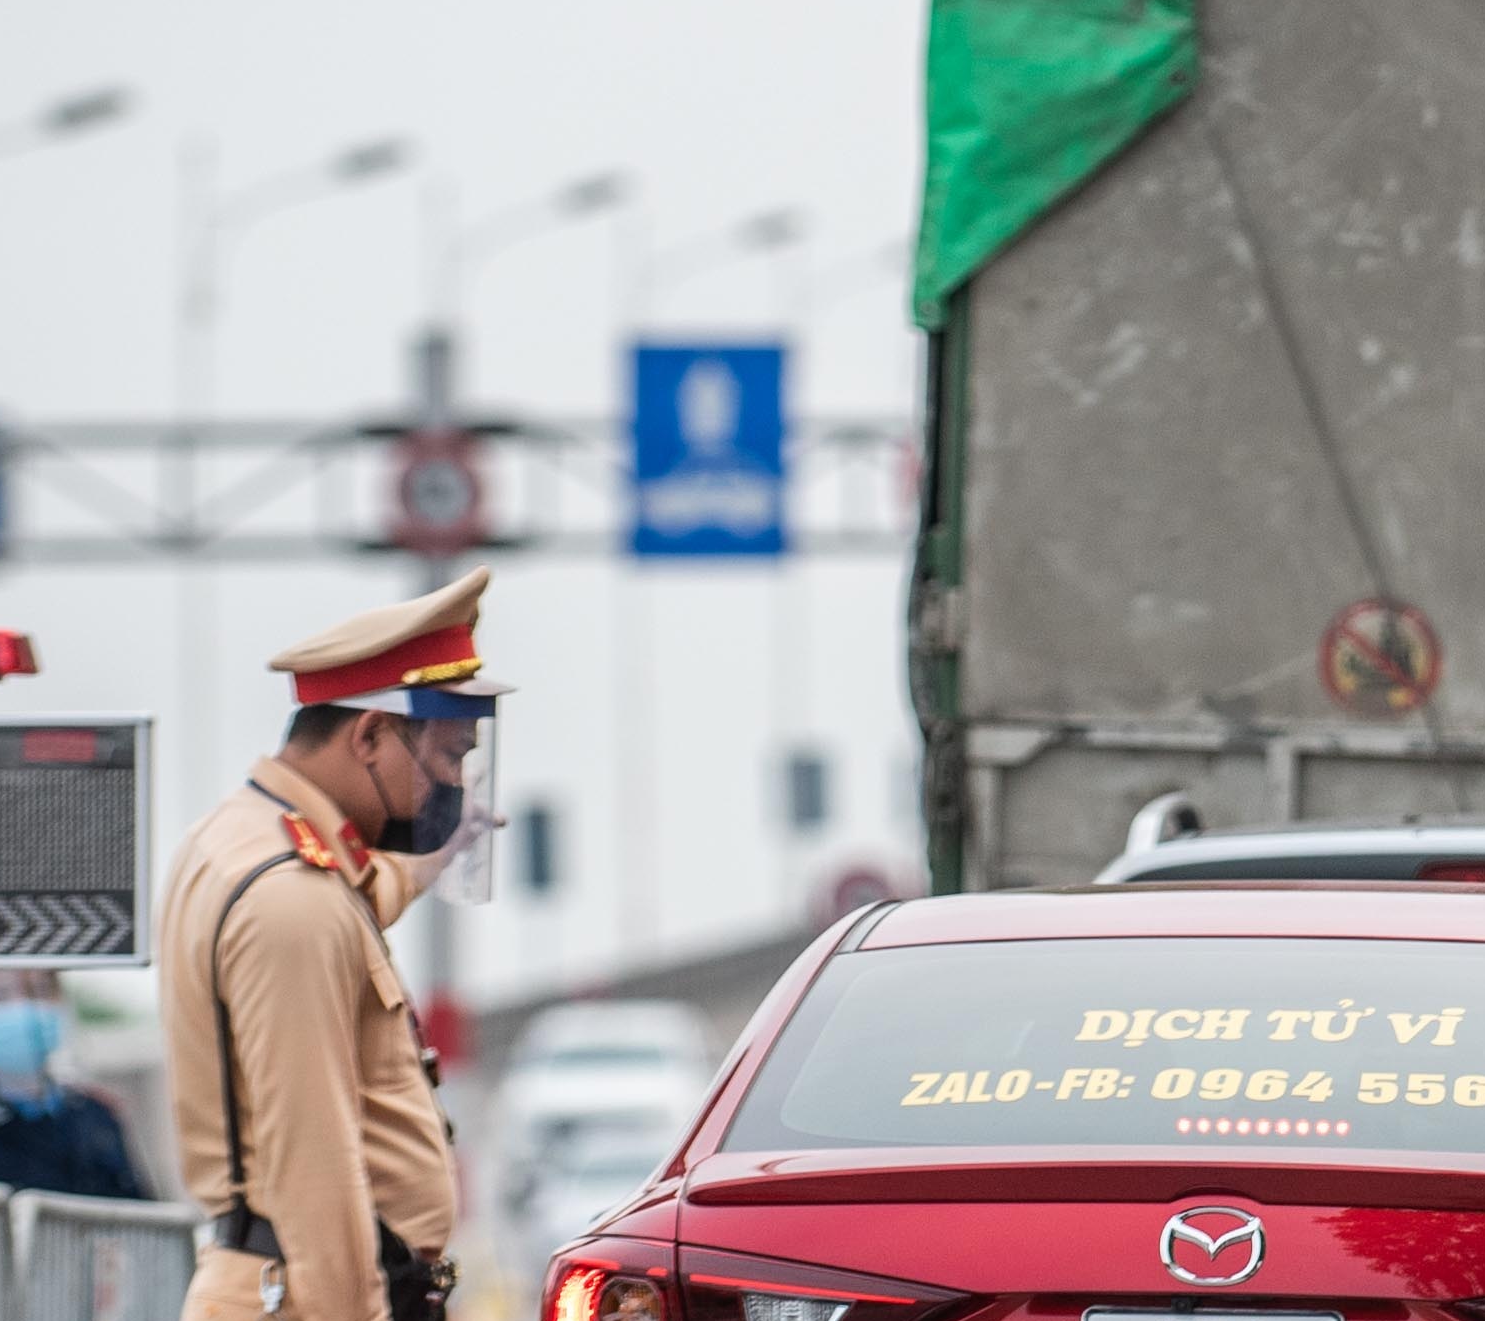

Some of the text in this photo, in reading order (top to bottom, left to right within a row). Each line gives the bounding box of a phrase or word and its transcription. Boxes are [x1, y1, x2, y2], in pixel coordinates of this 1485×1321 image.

[1074, 1008, 1252, 1048] DỊCH
[900, 1067, 1136, 1107] ZALO-FB:
[1149, 1067, 1334, 1104] 0964
